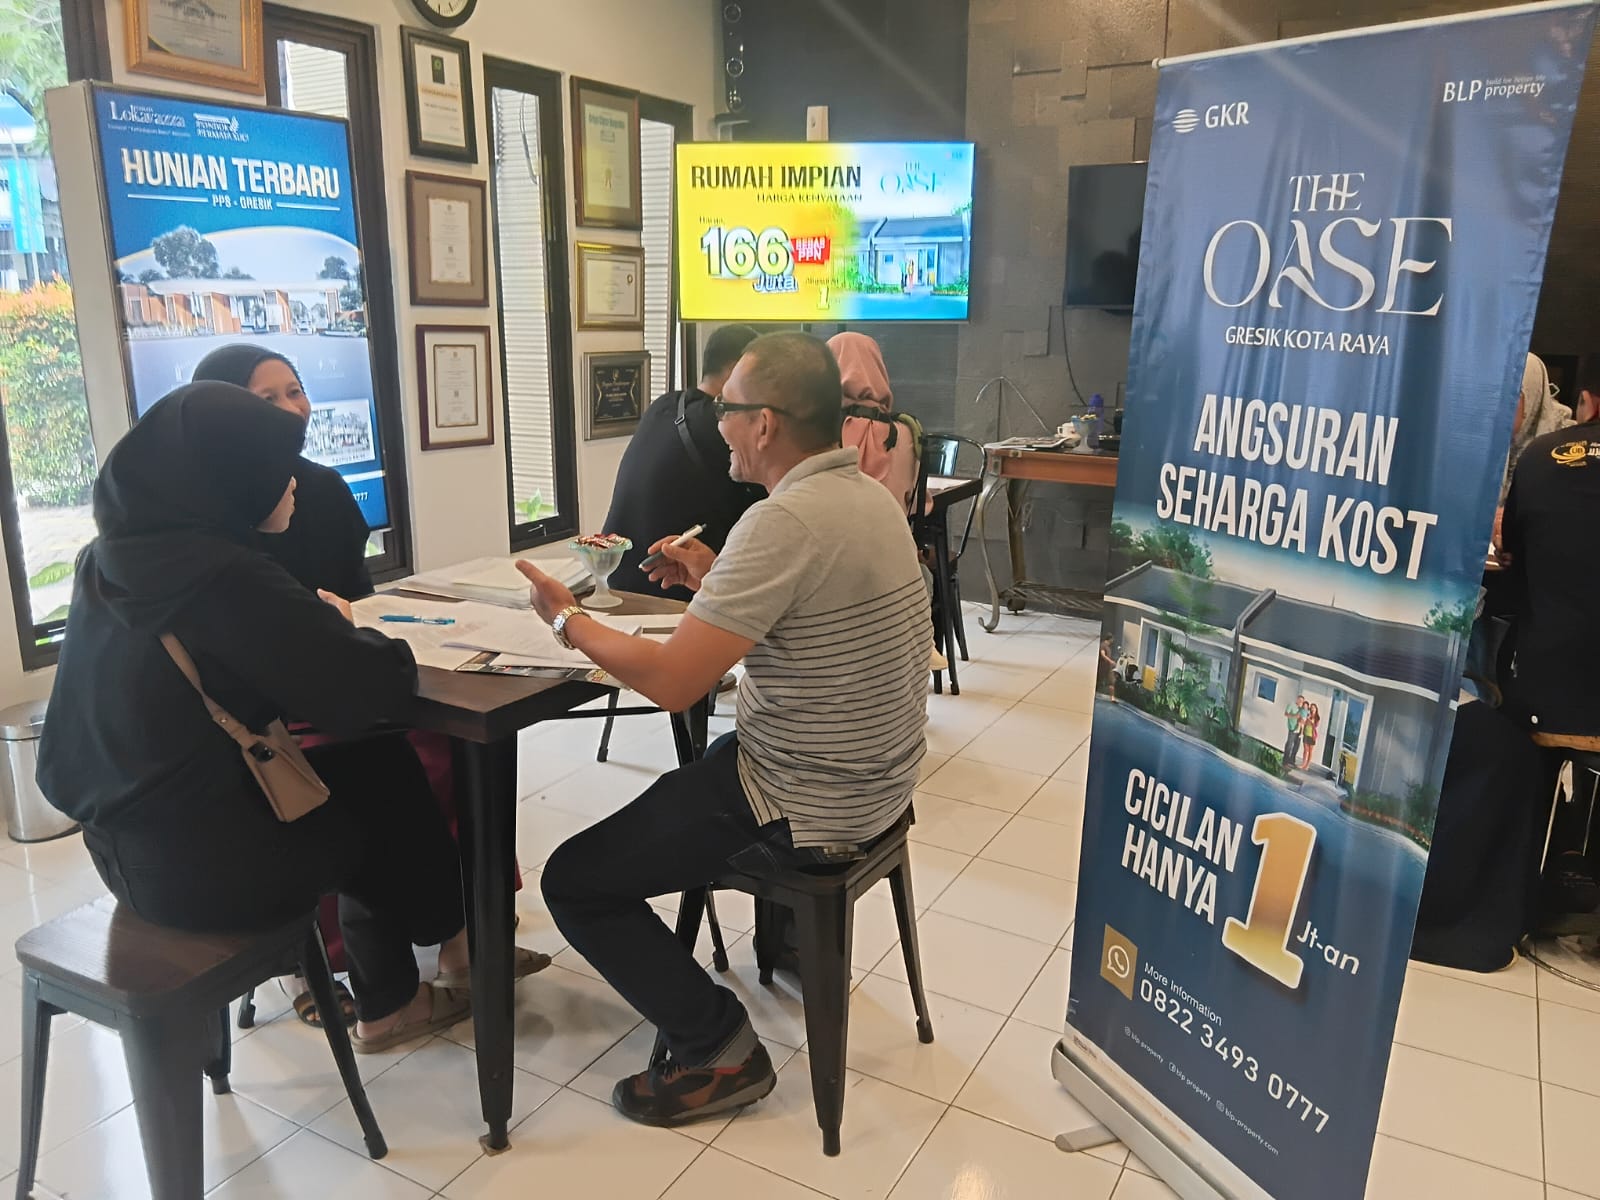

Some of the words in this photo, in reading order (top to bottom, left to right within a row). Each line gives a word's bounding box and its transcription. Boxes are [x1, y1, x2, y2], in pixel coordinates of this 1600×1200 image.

[1205, 102, 1249, 129] GKR
[1442, 79, 1483, 103] BLP
[1483, 80, 1545, 101] property
[121, 148, 228, 191] HUNIAN
[231, 156, 340, 199] TERBARU
[691, 164, 773, 190] RUMAH
[780, 164, 861, 189] IMPIAN
[1288, 172, 1365, 212] THE
[701, 225, 791, 277] 166
[798, 249, 823, 261] PPN
[1202, 216, 1453, 317] OASE
[752, 274, 799, 293] Juta
[1225, 325, 1282, 347] GRESIK
[1283, 329, 1335, 351] KOTA
[1338, 332, 1390, 356] RAYA
[1193, 393, 1399, 487] ANGSURAN
[1156, 462, 1309, 554] SEHARGA
[1317, 494, 1439, 581] KOST
[1123, 767, 1244, 873] CICILAN
[1120, 822, 1218, 926] HANYA
[1221, 811, 1318, 990] 1
[1296, 920, 1360, 976] Jt-an
[1143, 961, 1169, 987] More
[1170, 981, 1222, 1027] Information
[1139, 978, 1193, 1034] 0822
[1199, 1022, 1260, 1083] 3493
[1267, 1072, 1330, 1135] 0777
